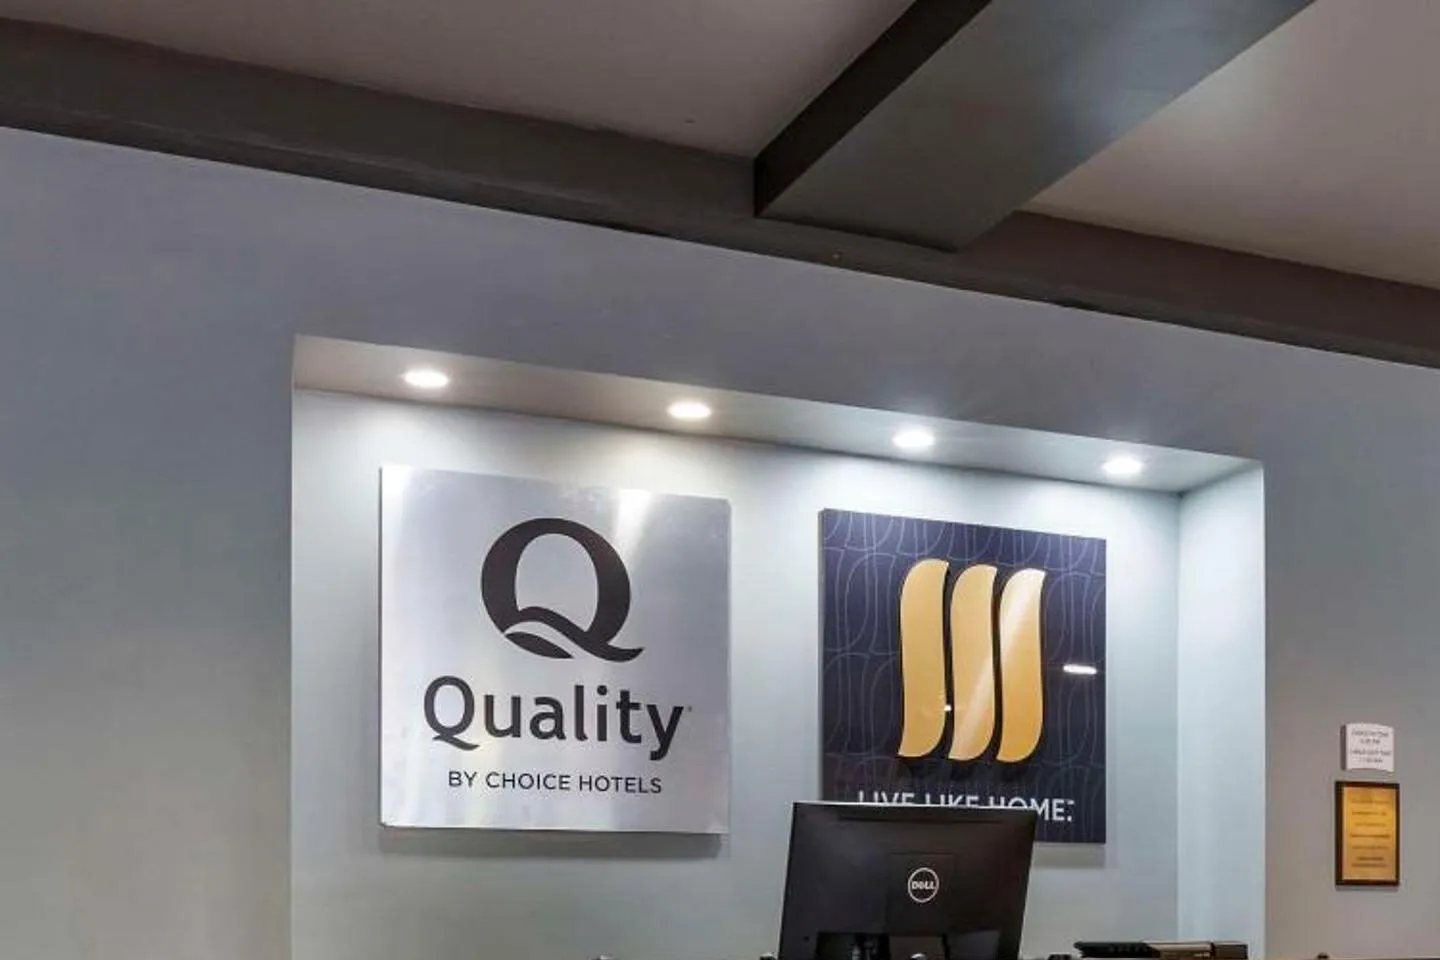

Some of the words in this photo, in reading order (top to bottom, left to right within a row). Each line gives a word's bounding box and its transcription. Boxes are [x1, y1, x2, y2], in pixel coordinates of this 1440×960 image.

[481, 517, 645, 663] Q
[423, 675, 685, 761] Quality
[448, 771, 477, 787] BY
[485, 772, 571, 790] CHOICE
[579, 775, 663, 794] HOTELS
